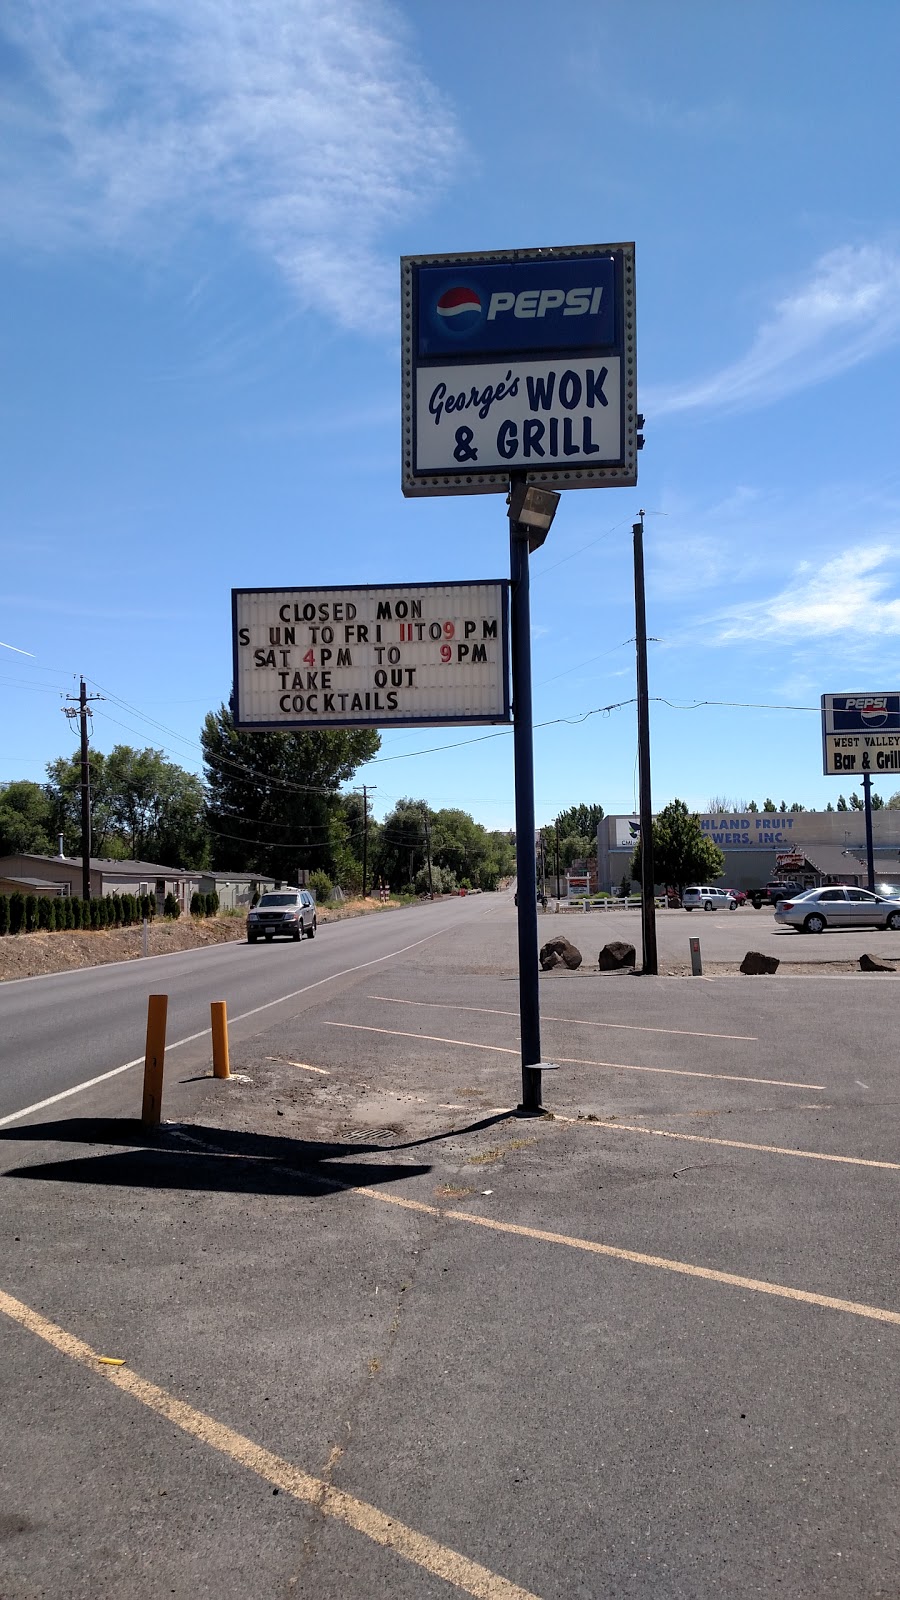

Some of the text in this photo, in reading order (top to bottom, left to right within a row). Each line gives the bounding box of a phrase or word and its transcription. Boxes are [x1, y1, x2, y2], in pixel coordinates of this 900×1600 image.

[486, 286, 604, 321] PEPSI
[428, 366, 609, 425] George's WOK
[453, 416, 600, 462] & GRILL
[279, 600, 422, 623] CLOSED MON
[309, 625, 335, 645] TO
[345, 624, 382, 643] FRI
[254, 648, 291, 668] SAT
[374, 646, 401, 665] TO
[278, 668, 416, 690] TAKE OUT
[279, 691, 398, 713] COCKTAILS
[845, 698, 888, 709] PEPSI
[833, 737, 900, 747] WEST VALLEY
[834, 750, 900, 770] Bar & Grill
[701, 818, 794, 830] HLAND FRUIT
[758, 832, 787, 843] INC.
